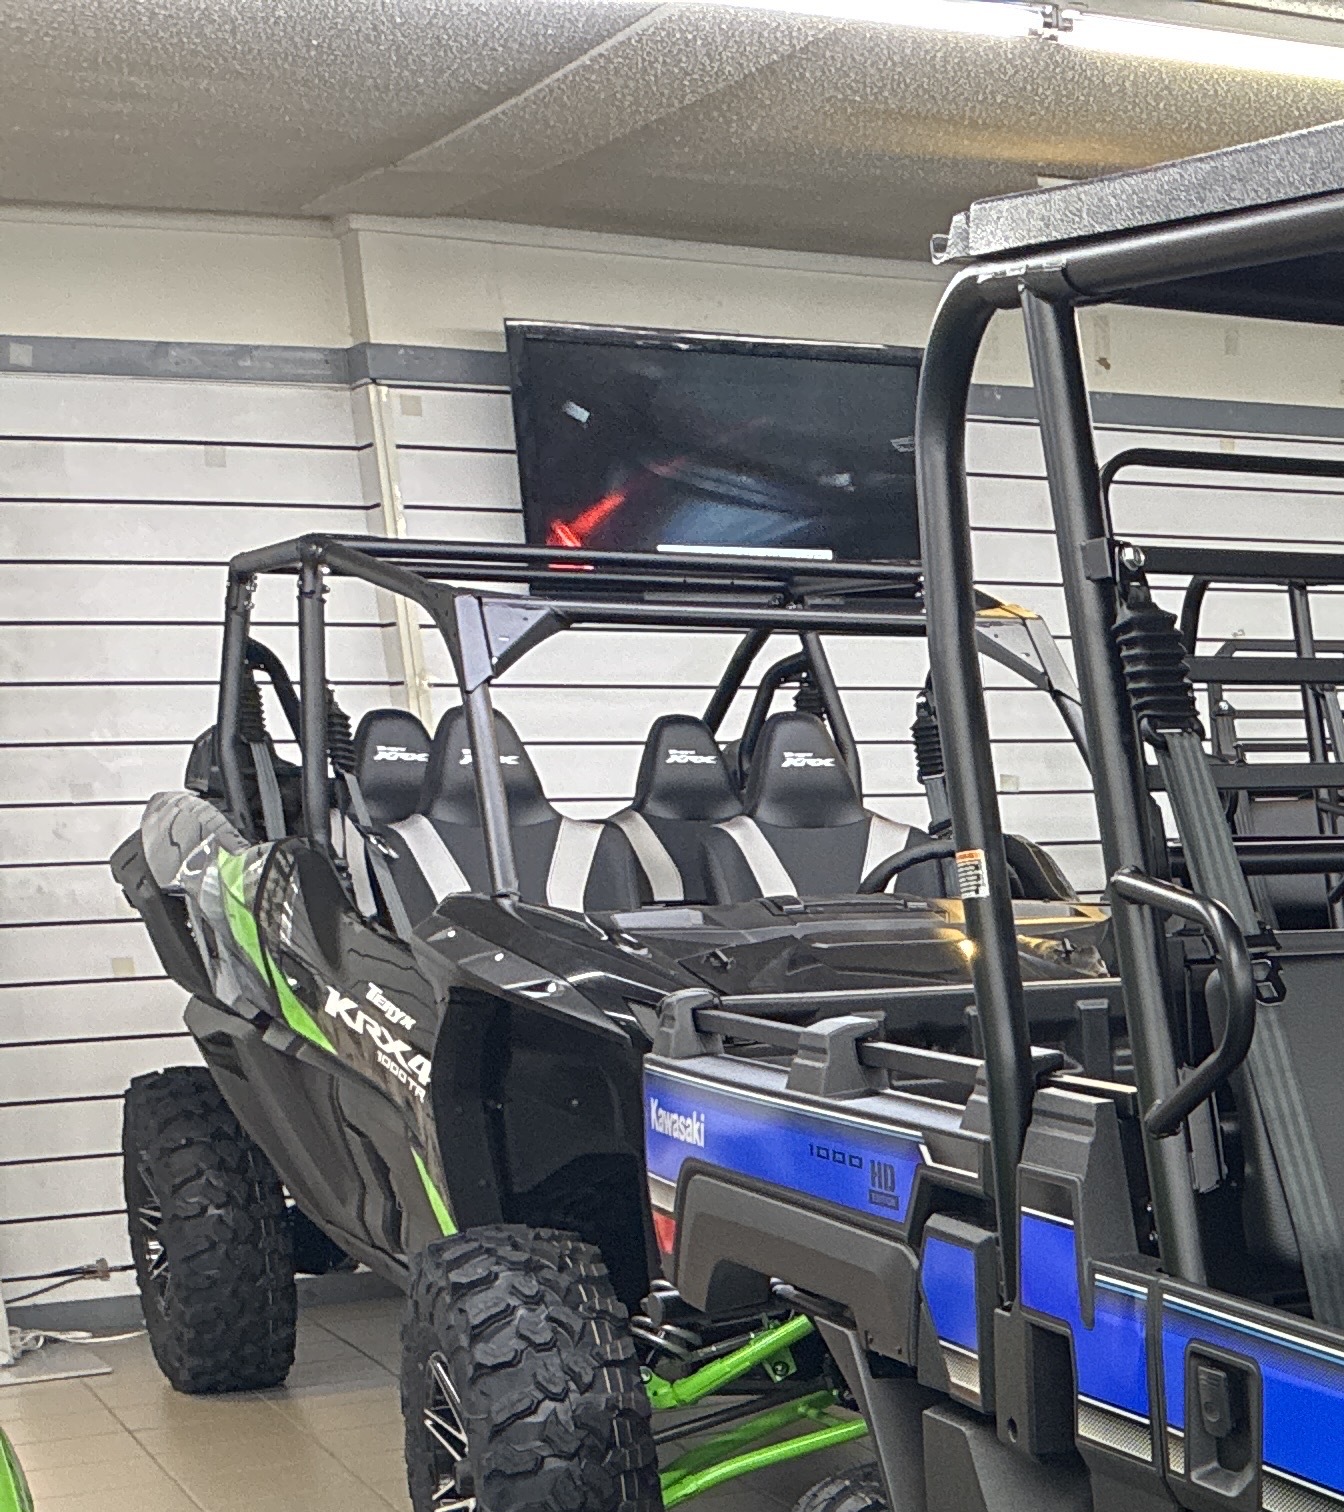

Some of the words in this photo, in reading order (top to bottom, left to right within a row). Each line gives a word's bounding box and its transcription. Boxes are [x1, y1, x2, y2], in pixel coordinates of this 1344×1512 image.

[651, 1097, 705, 1148] Kawasaki
[809, 1143, 863, 1170] 1000
[870, 1159, 896, 1192] HD
